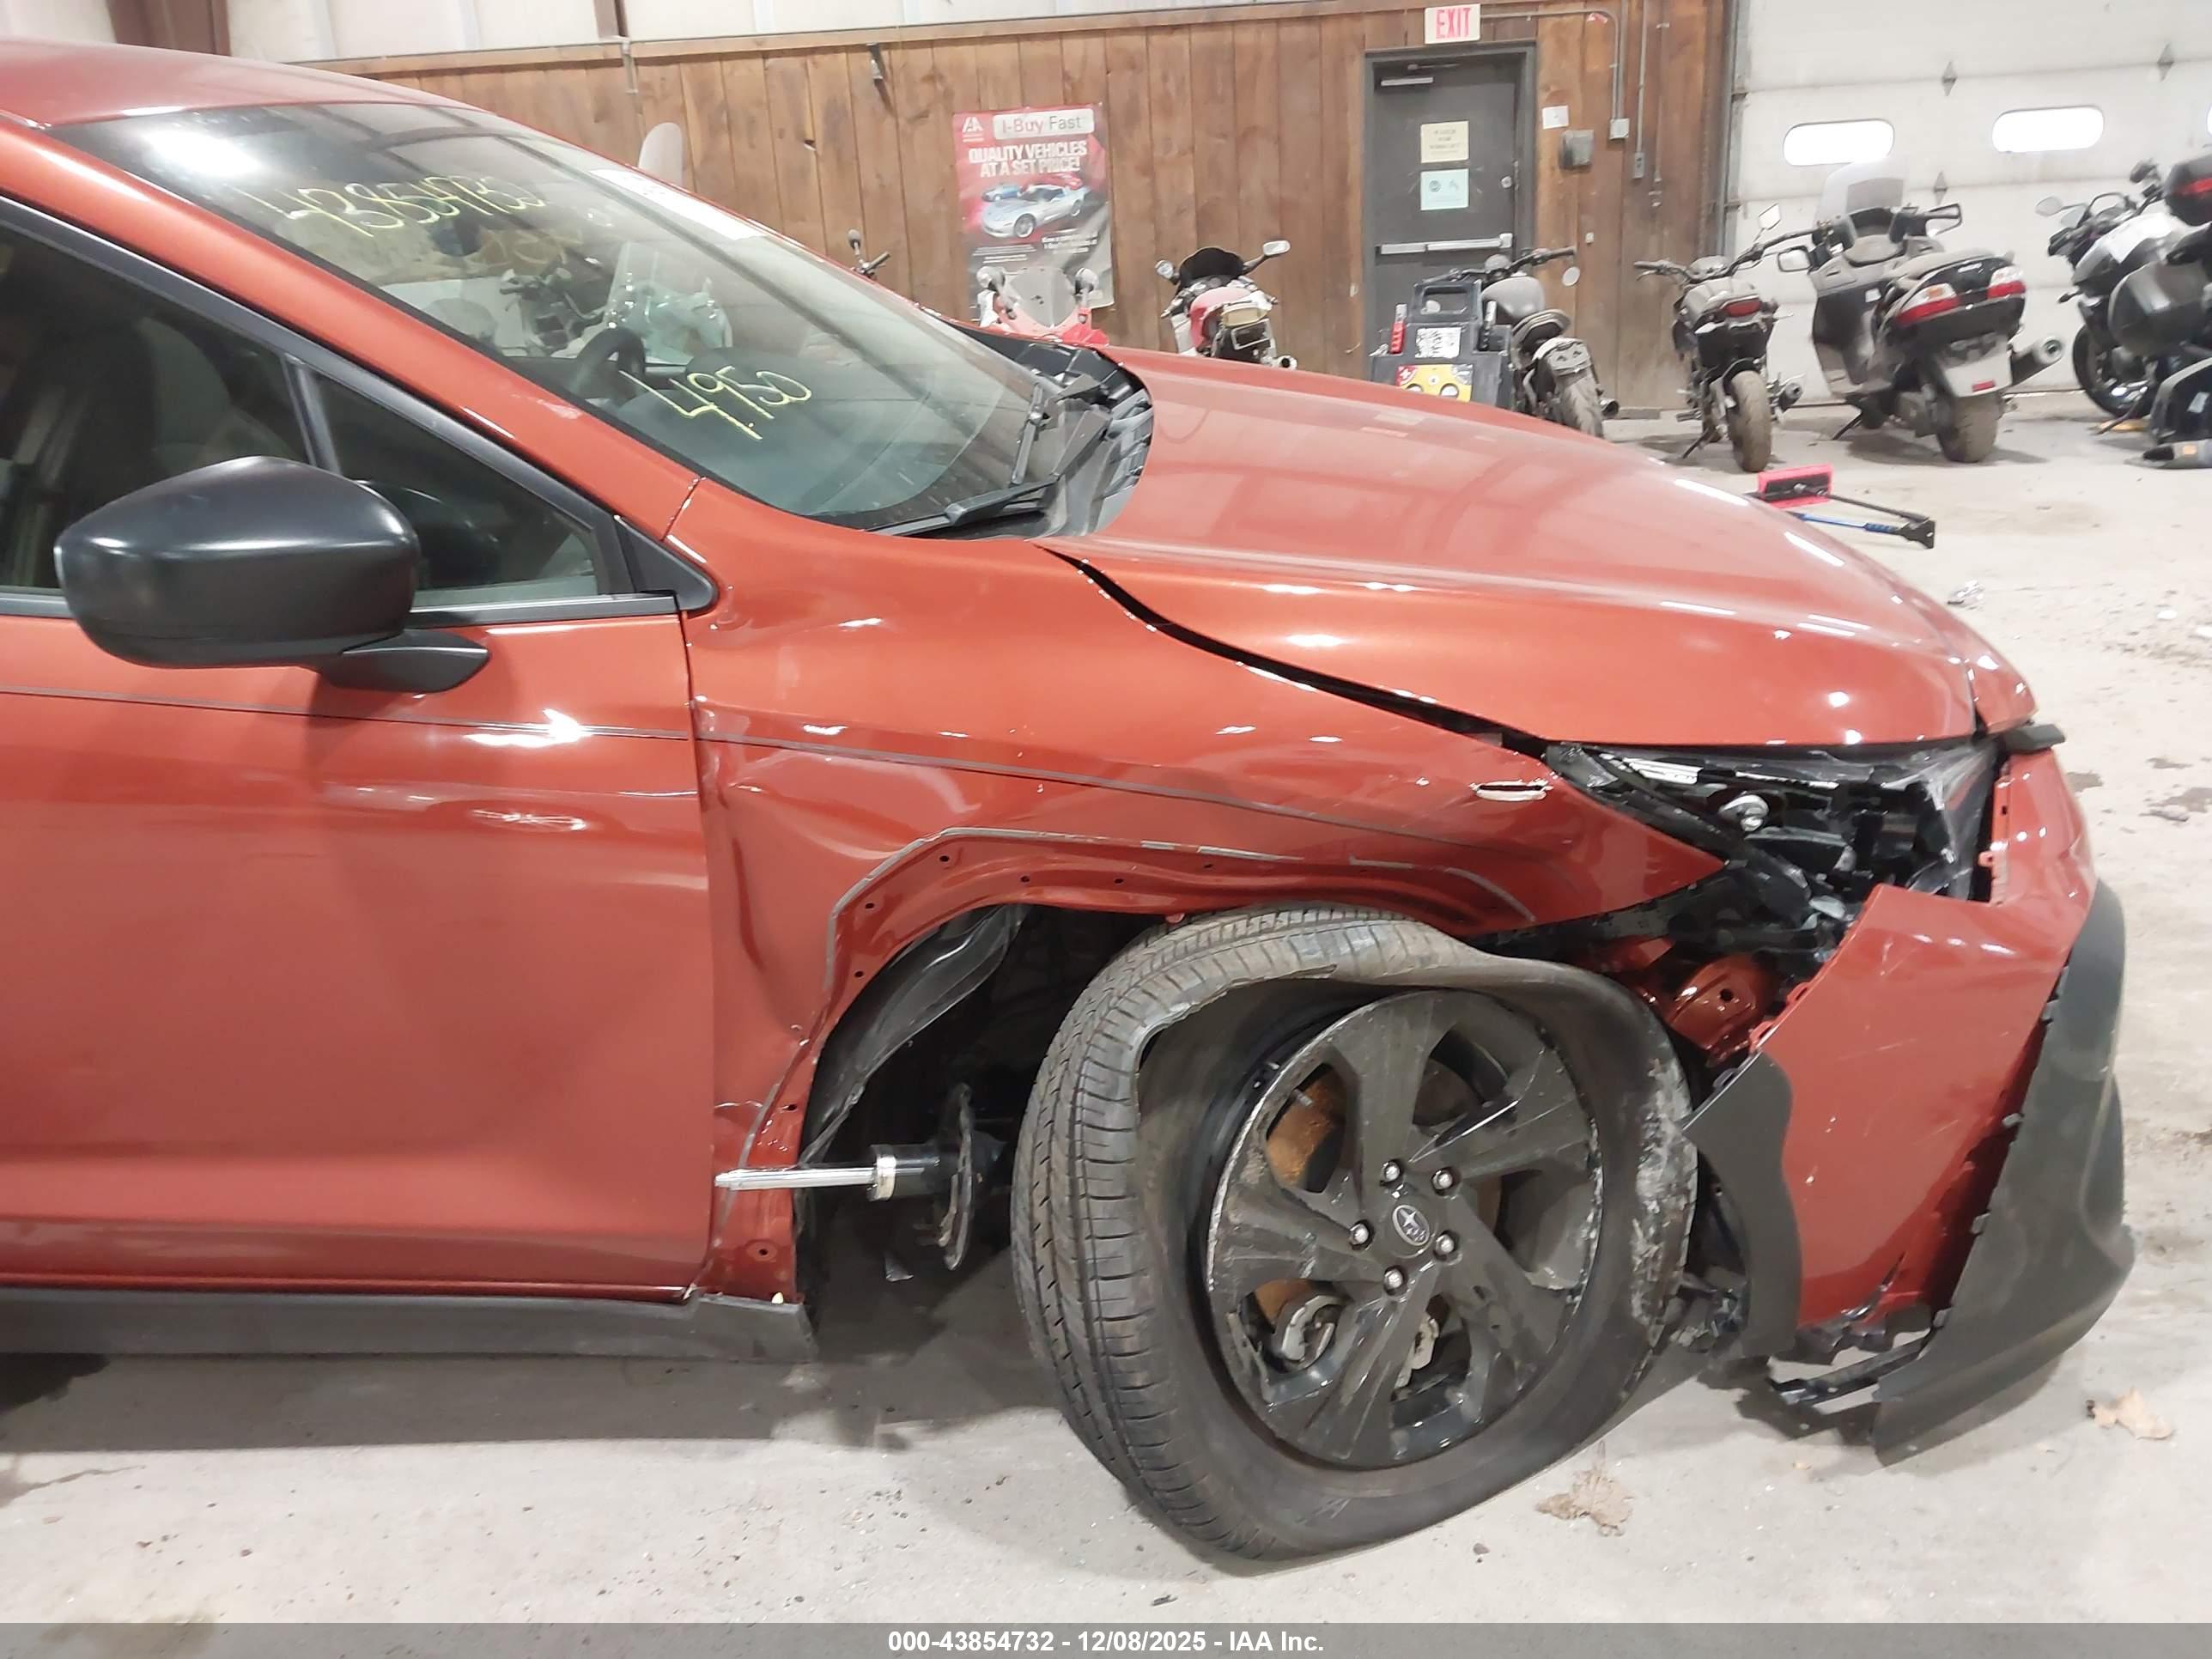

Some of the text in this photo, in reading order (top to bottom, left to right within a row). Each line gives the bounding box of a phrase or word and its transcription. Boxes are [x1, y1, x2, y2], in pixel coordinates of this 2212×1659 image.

[1435, 7, 1472, 40] EXIT
[1002, 115, 1081, 134] I-Buy Fast
[968, 140, 1088, 164] QUALITY VEHICLES
[980, 161, 999, 178] AT
[999, 161, 1011, 176] A
[1011, 160, 1036, 176] SET
